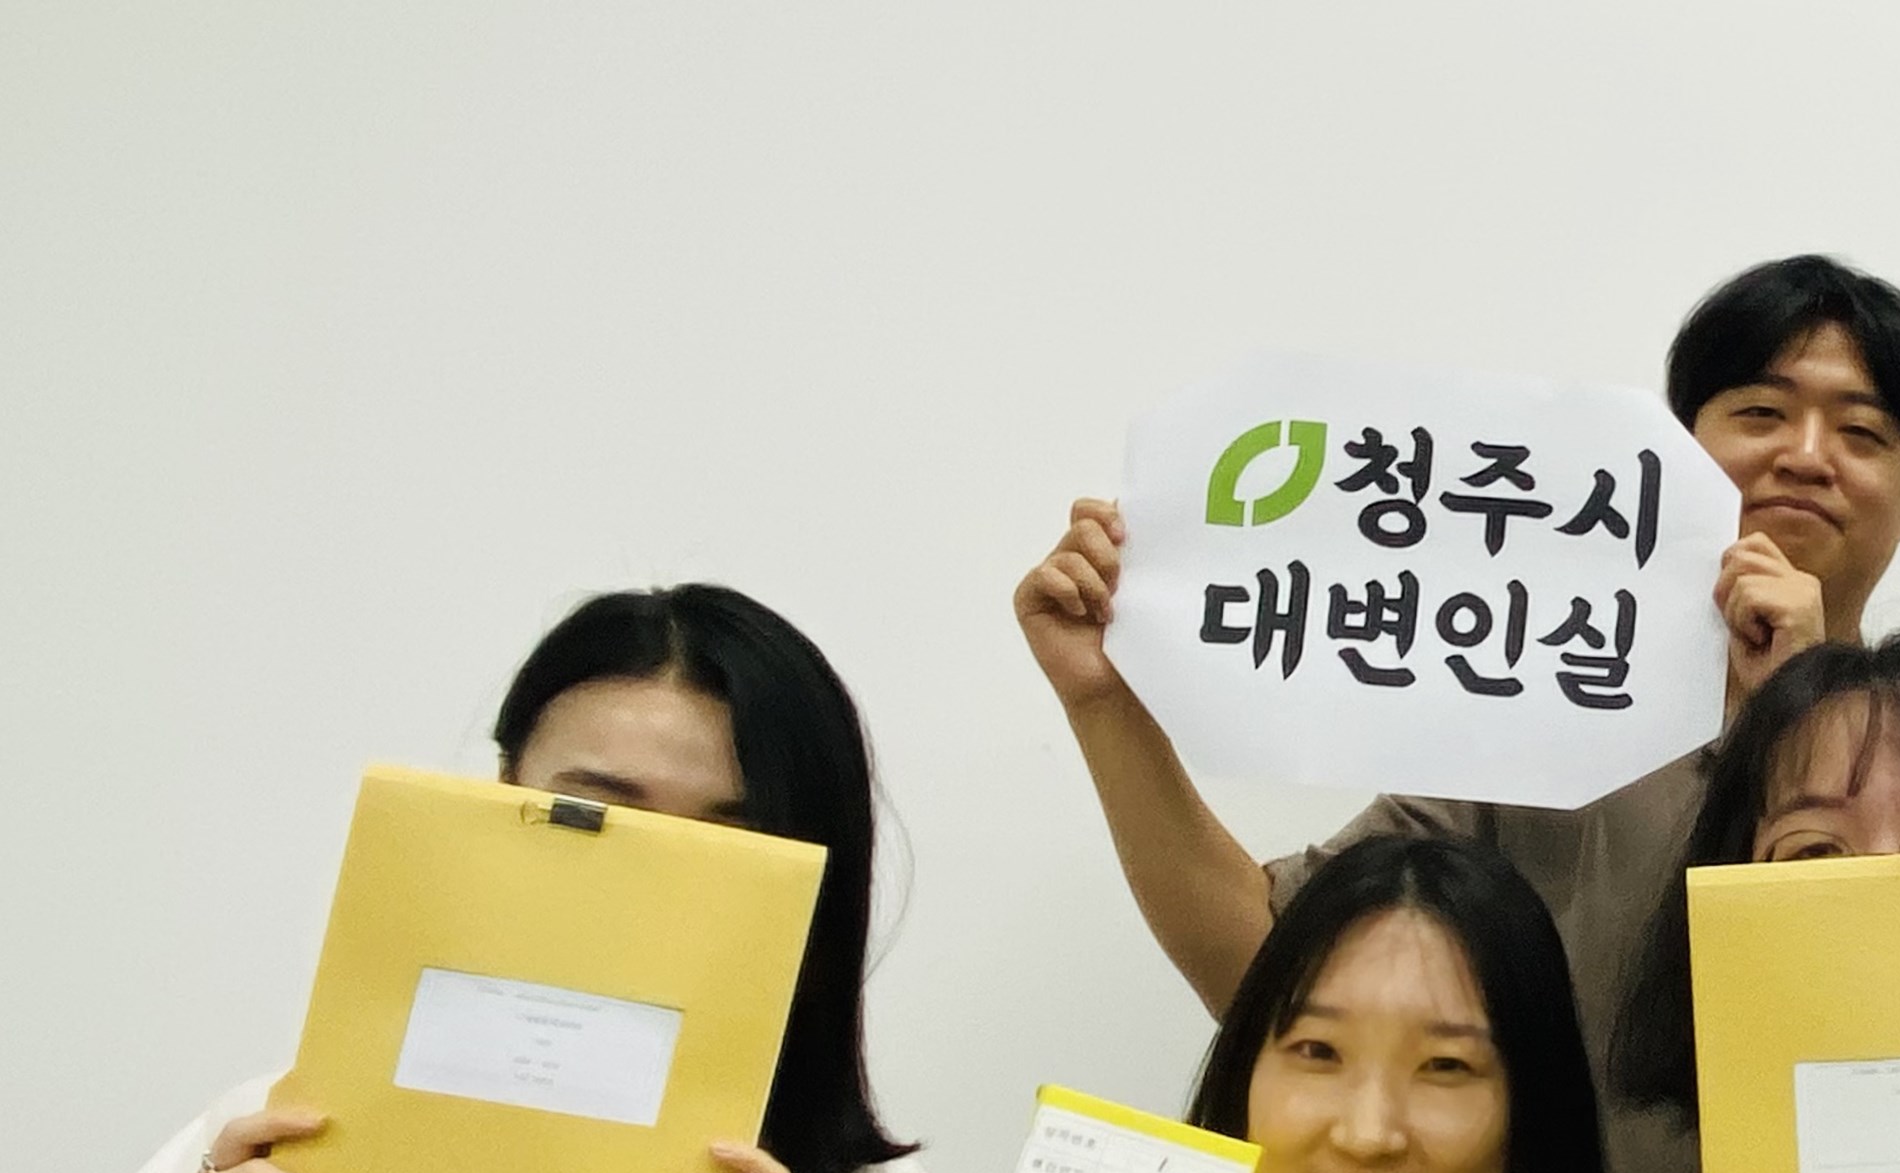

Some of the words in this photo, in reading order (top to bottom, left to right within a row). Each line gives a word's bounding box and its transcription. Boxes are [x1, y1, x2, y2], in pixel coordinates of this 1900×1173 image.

[1334, 426, 1662, 570] 청주시
[1199, 560, 1638, 711] 대변인실
[1158, 1157, 1168, 1173] 1
